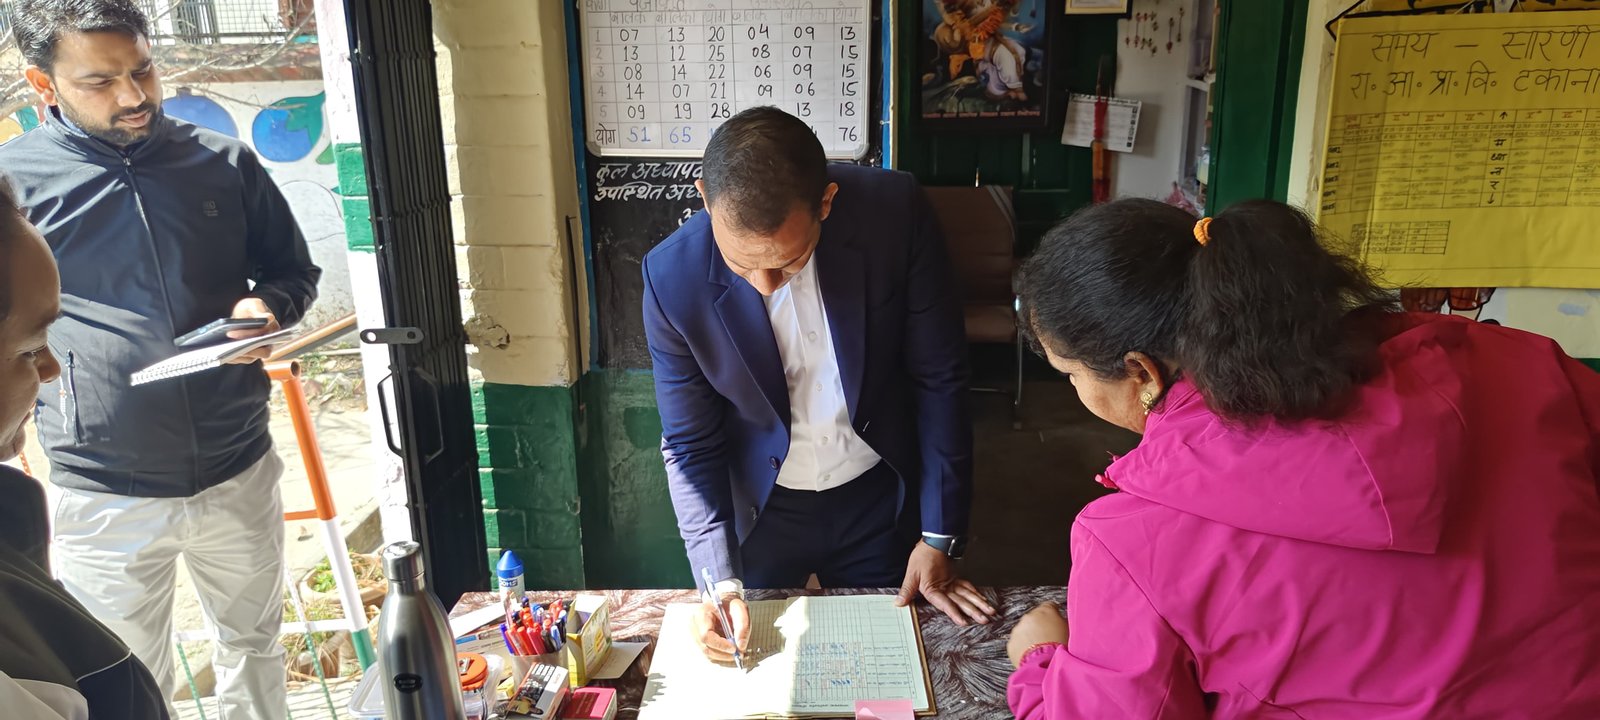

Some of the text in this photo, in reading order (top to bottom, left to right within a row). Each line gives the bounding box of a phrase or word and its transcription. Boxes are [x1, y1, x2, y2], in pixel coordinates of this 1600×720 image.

[620, 29, 639, 41] 07
[668, 27, 685, 42] 13
[708, 26, 725, 42] 20
[748, 24, 769, 40] 04
[794, 26, 814, 40] 09
[840, 26, 856, 40] 13
[624, 45, 639, 61] 13
[670, 45, 686, 61] 12
[708, 44, 725, 61] 25
[752, 44, 770, 58] 08
[792, 45, 812, 59] 07
[841, 45, 859, 59] 15
[1371, 32, 1439, 62] समय
[1502, 24, 1595, 62] सारणी
[624, 63, 642, 80] 08
[672, 64, 687, 80] 14
[709, 64, 725, 80] 22
[754, 65, 771, 78] 06
[793, 63, 812, 79] 09
[841, 63, 855, 78] 15
[626, 83, 645, 100] 14
[672, 84, 690, 98] 07
[710, 82, 726, 99] 21
[758, 85, 772, 97] 09
[795, 82, 815, 96] 06
[841, 81, 859, 96] 15
[627, 104, 645, 119] 09
[674, 103, 692, 119] 19
[711, 102, 731, 119] 28
[796, 102, 811, 117] 13
[839, 101, 855, 117] 18
[596, 123, 616, 145] योग
[627, 126, 651, 142] 51
[669, 126, 691, 143] 65
[838, 127, 857, 141] 76
[596, 162, 632, 186] कुल
[594, 181, 667, 201] उपस्थित
